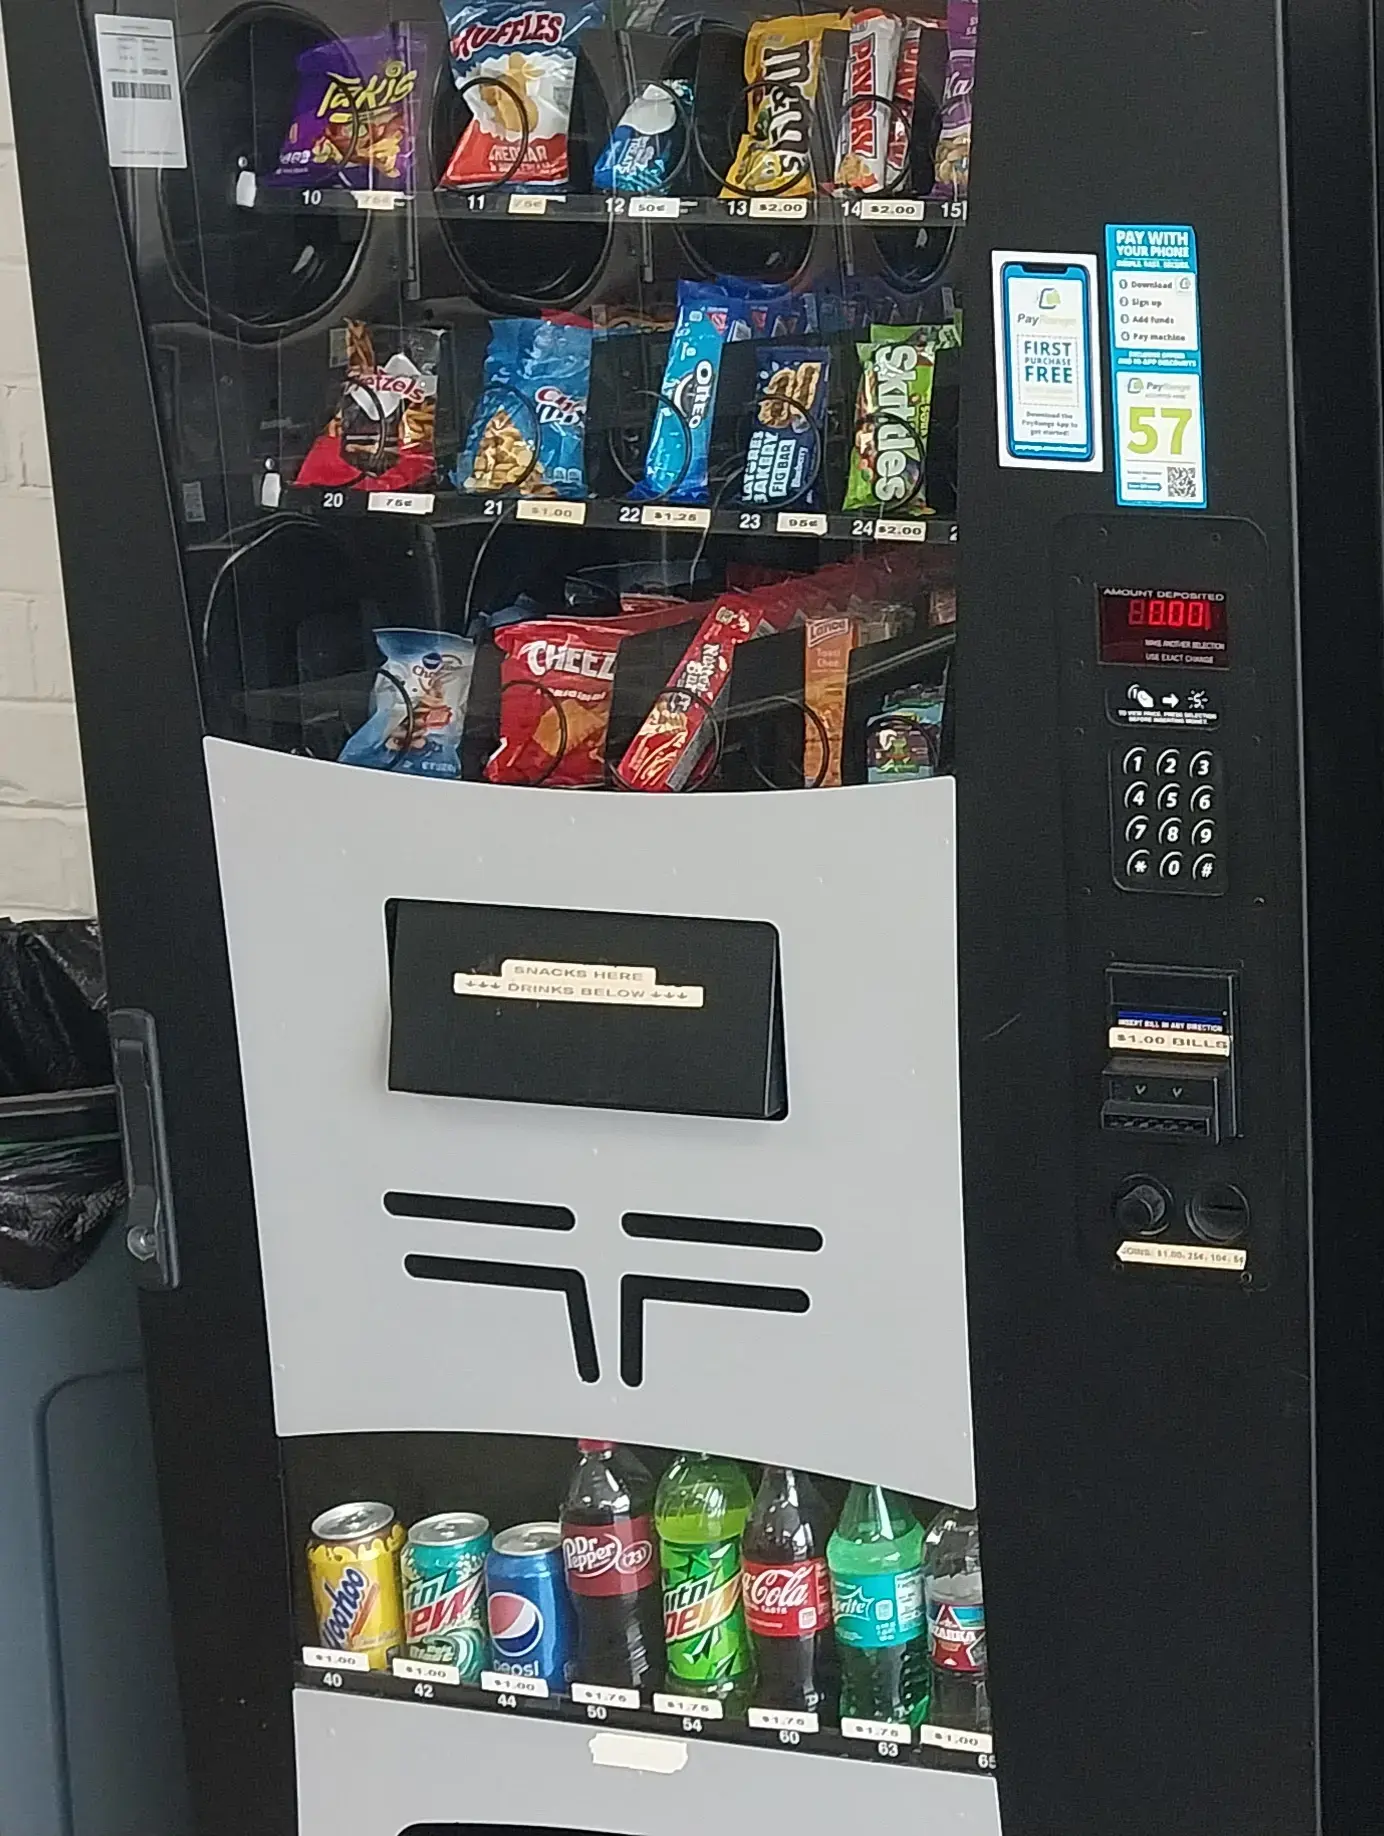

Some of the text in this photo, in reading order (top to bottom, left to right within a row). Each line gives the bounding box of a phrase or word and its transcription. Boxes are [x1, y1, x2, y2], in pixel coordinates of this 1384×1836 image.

[451, 12, 565, 60] RUFFLES
[317, 60, 418, 118] Takis
[302, 190, 322, 205] 10
[467, 194, 485, 210] 11
[605, 197, 626, 214] 12
[728, 200, 803, 216] 13 $2.00
[841, 202, 916, 217] 14 $2.00
[941, 202, 962, 218] 15
[1115, 230, 1189, 247] PAY WITH
[1116, 245, 1190, 258] YOUR PHONE
[1131, 281, 1173, 290] Download
[1132, 299, 1162, 309] Sign up
[1132, 316, 1149, 324] Add
[1133, 333, 1186, 342] Pay machine
[1024, 340, 1072, 357] FIRST
[1024, 357, 1071, 366] PURCHASE
[1024, 365, 1073, 384] FREE
[689, 360, 712, 430] OREO
[875, 345, 919, 501] Skittles
[1127, 406, 1193, 455] 57
[772, 444, 793, 493] FIG BAR
[323, 492, 343, 508] 20
[483, 500, 502, 516] 21
[619, 507, 639, 523] 22
[739, 513, 761, 529] 23
[852, 520, 922, 536] 24 $2.00
[1103, 587, 1225, 602] AMOUNT DEPOSITED
[810, 620, 848, 640] Lance
[526, 640, 618, 681] CHEEZ
[1161, 653, 1184, 663] EXACT
[1133, 756, 1210, 776] 1 2 3
[1132, 790, 1211, 810] 4 5 6
[1134, 824, 1212, 844] 7 8 9
[1168, 860, 1180, 876] 0
[513, 965, 644, 983] SNACKS HERE
[507, 982, 646, 1000] DRINKS BELOW
[1117, 1034, 1228, 1049] $1.00 BILLS
[564, 1538, 644, 1572] Pepper 23
[322, 1672, 343, 1689] 40
[414, 1683, 435, 1699] 42
[497, 1694, 518, 1709] 44
[586, 1705, 608, 1720] 50
[682, 1718, 703, 1733] 54
[778, 1730, 800, 1746] 60
[877, 1741, 899, 1758] 63
